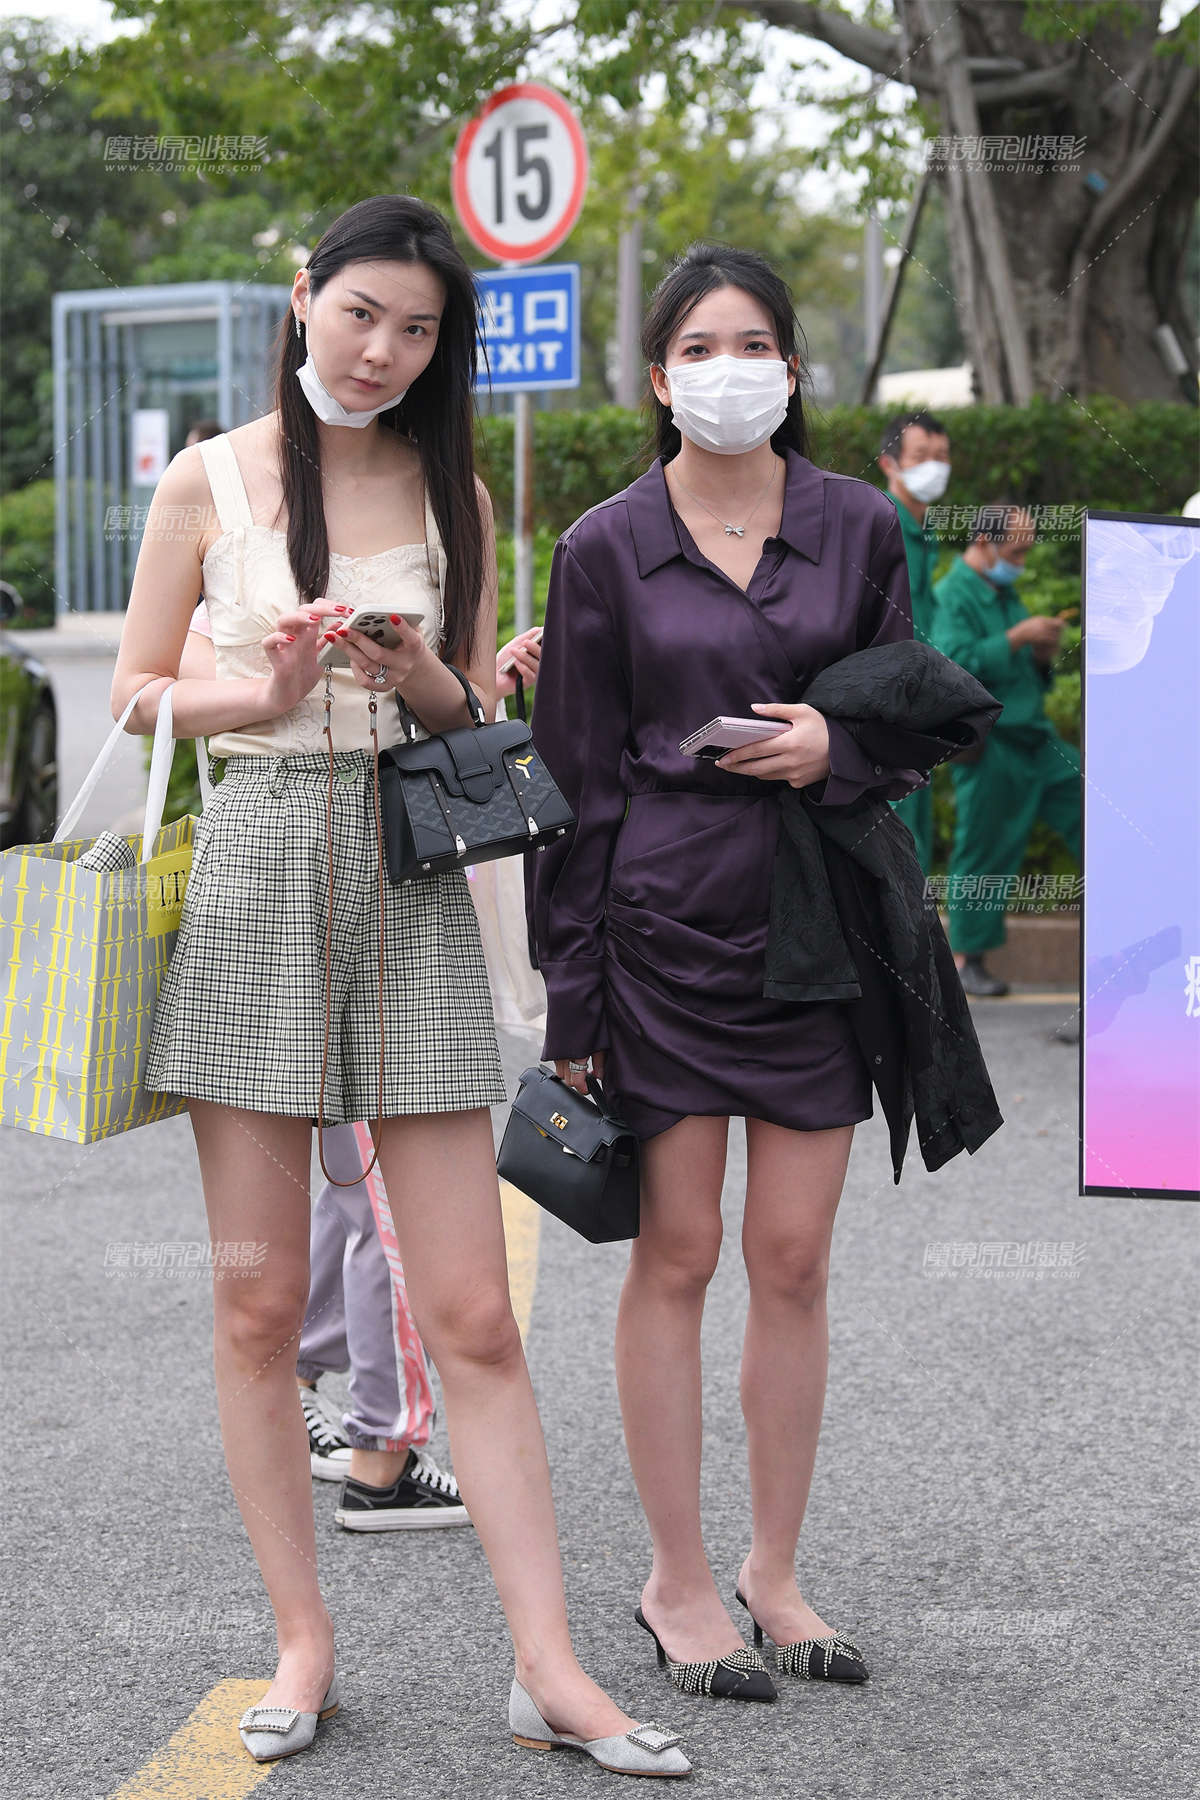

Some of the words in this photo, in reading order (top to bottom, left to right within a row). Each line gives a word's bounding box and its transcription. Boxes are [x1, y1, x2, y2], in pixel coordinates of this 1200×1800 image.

[483, 123, 553, 225] 15
[474, 290, 568, 339] 出口
[475, 341, 563, 374] EXIT
